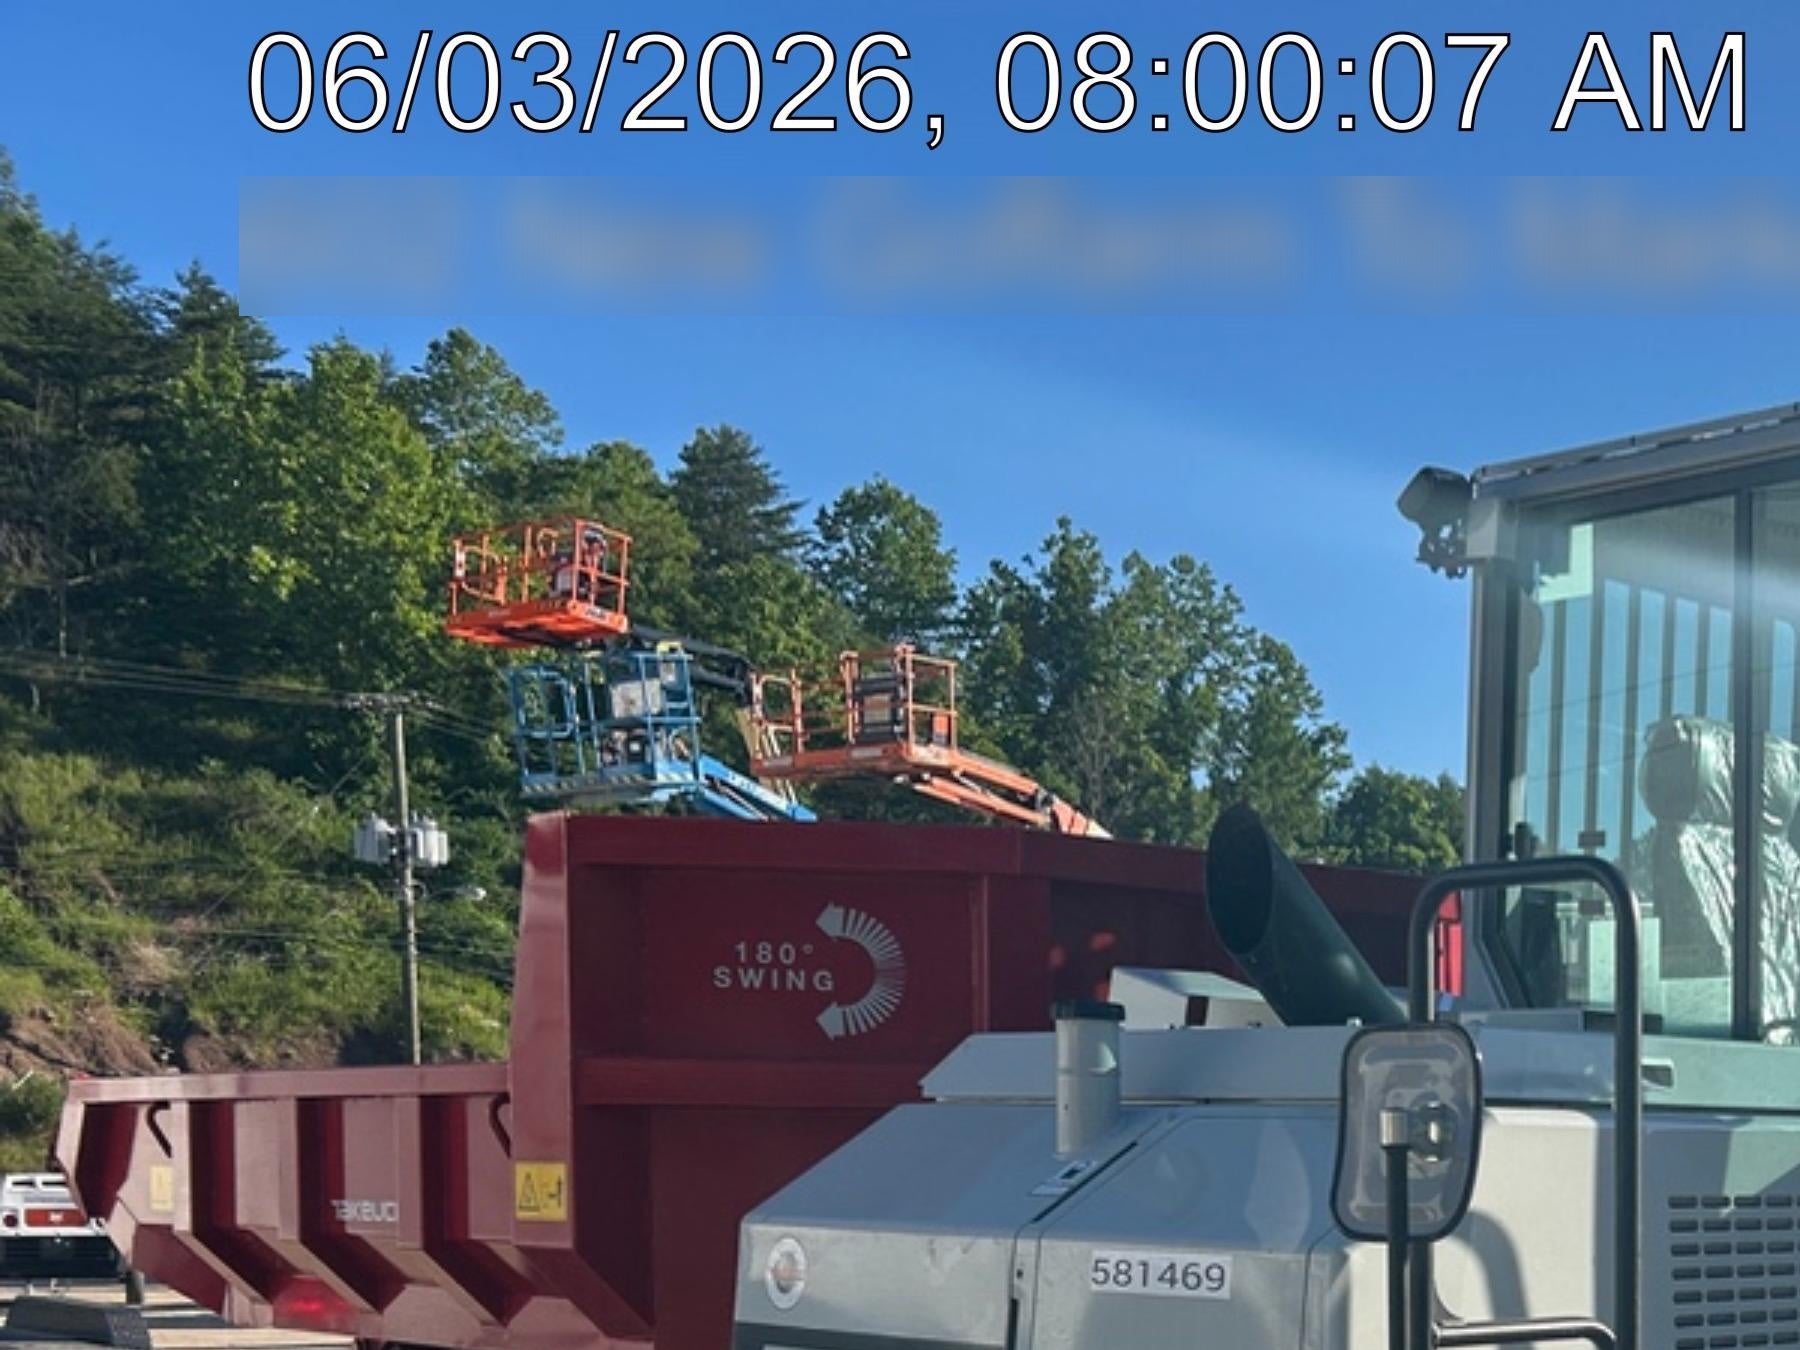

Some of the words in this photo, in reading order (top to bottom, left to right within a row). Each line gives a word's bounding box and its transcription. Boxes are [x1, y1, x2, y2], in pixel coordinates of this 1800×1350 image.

[735, 941, 814, 964] 180°
[713, 965, 834, 991] SWING
[1091, 1258, 1226, 1292] 581469
